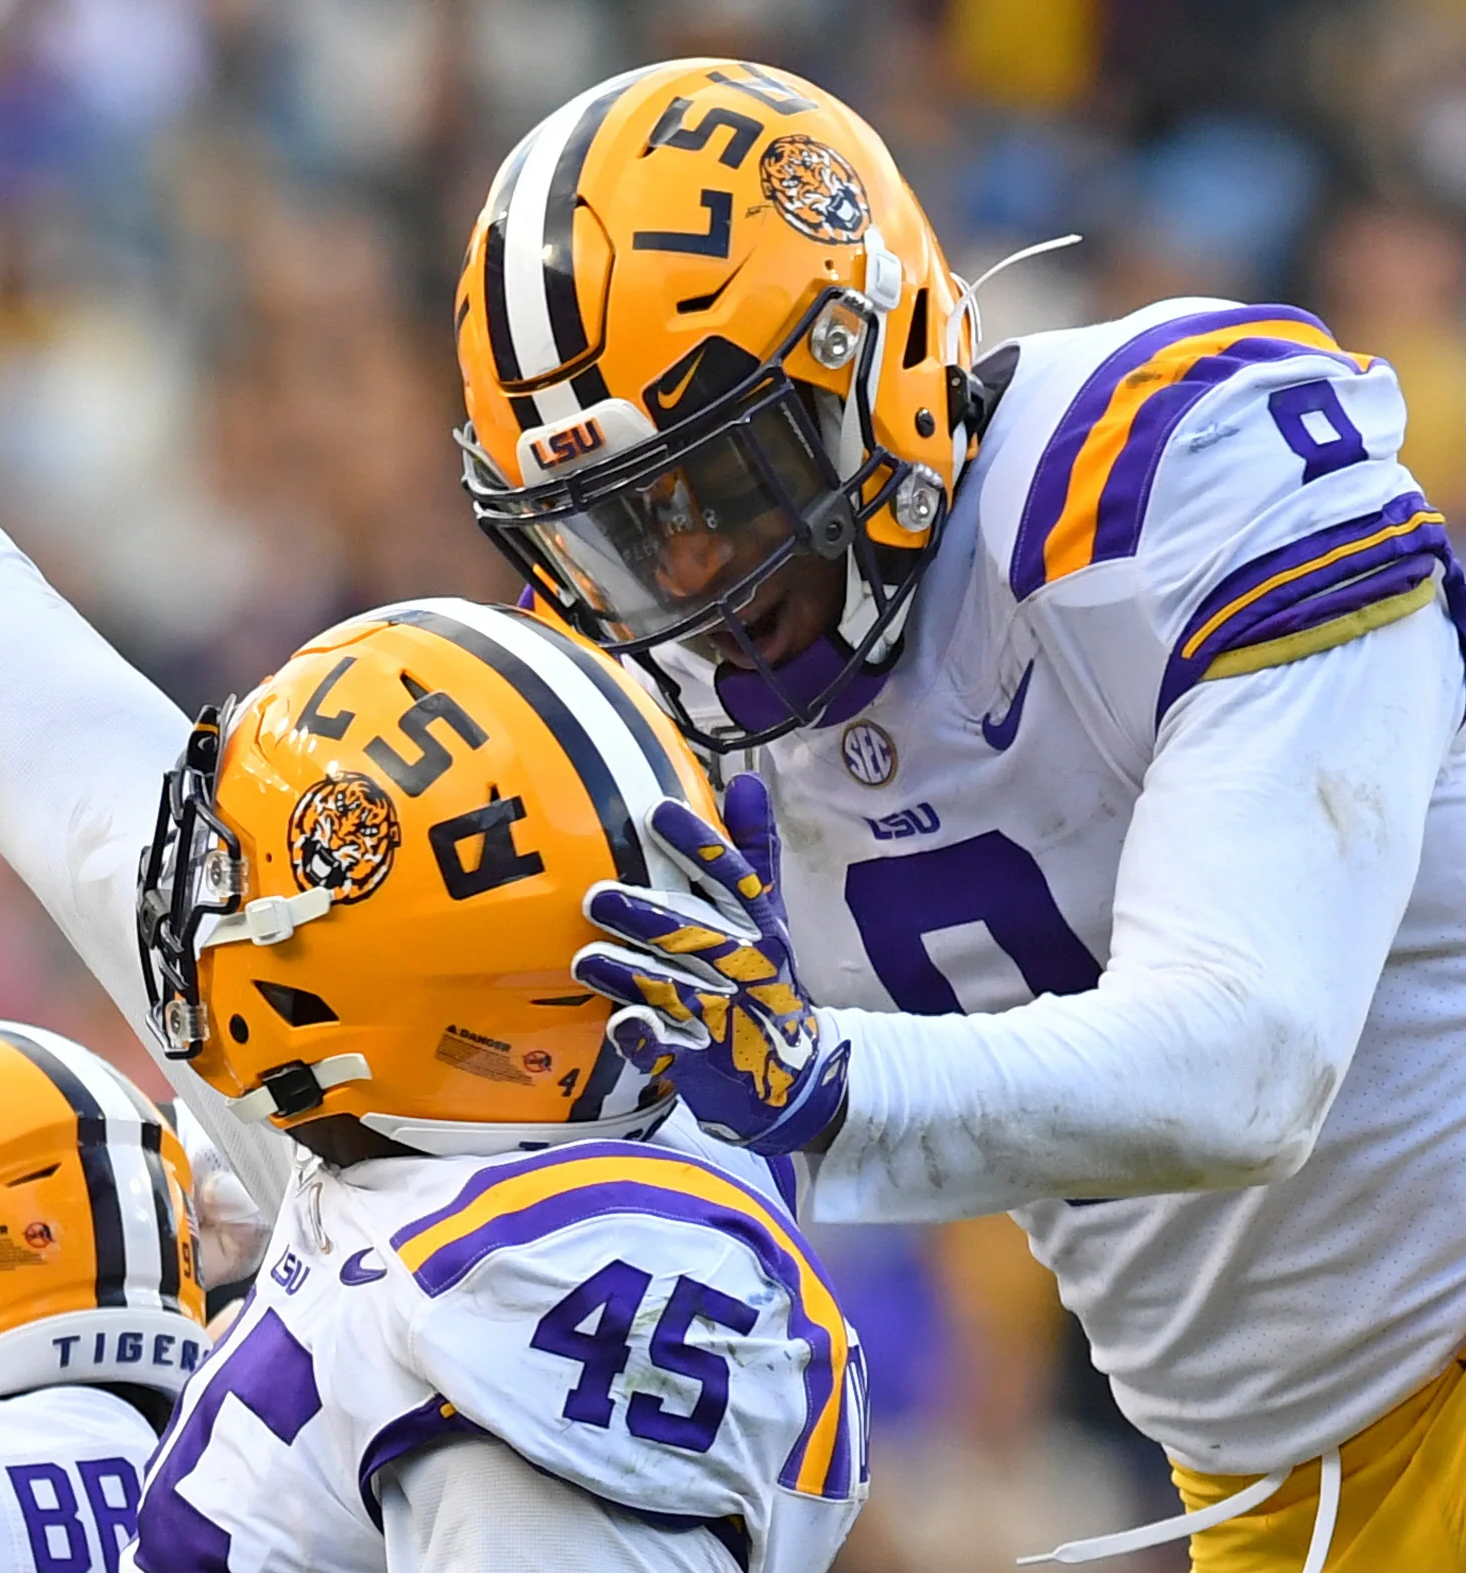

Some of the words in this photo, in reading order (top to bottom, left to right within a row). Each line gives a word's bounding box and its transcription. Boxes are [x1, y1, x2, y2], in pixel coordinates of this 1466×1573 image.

[632, 64, 819, 259] LSU
[529, 416, 606, 470] LSU
[294, 656, 547, 901] LSU
[844, 726, 894, 784] SEC
[862, 802, 941, 840] LSU
[459, 1029, 512, 1053] DANGER
[557, 1068, 581, 1097] 4
[270, 1243, 311, 1296] LSU
[52, 1332, 210, 1373] TIGER
[529, 1258, 761, 1454] 45
